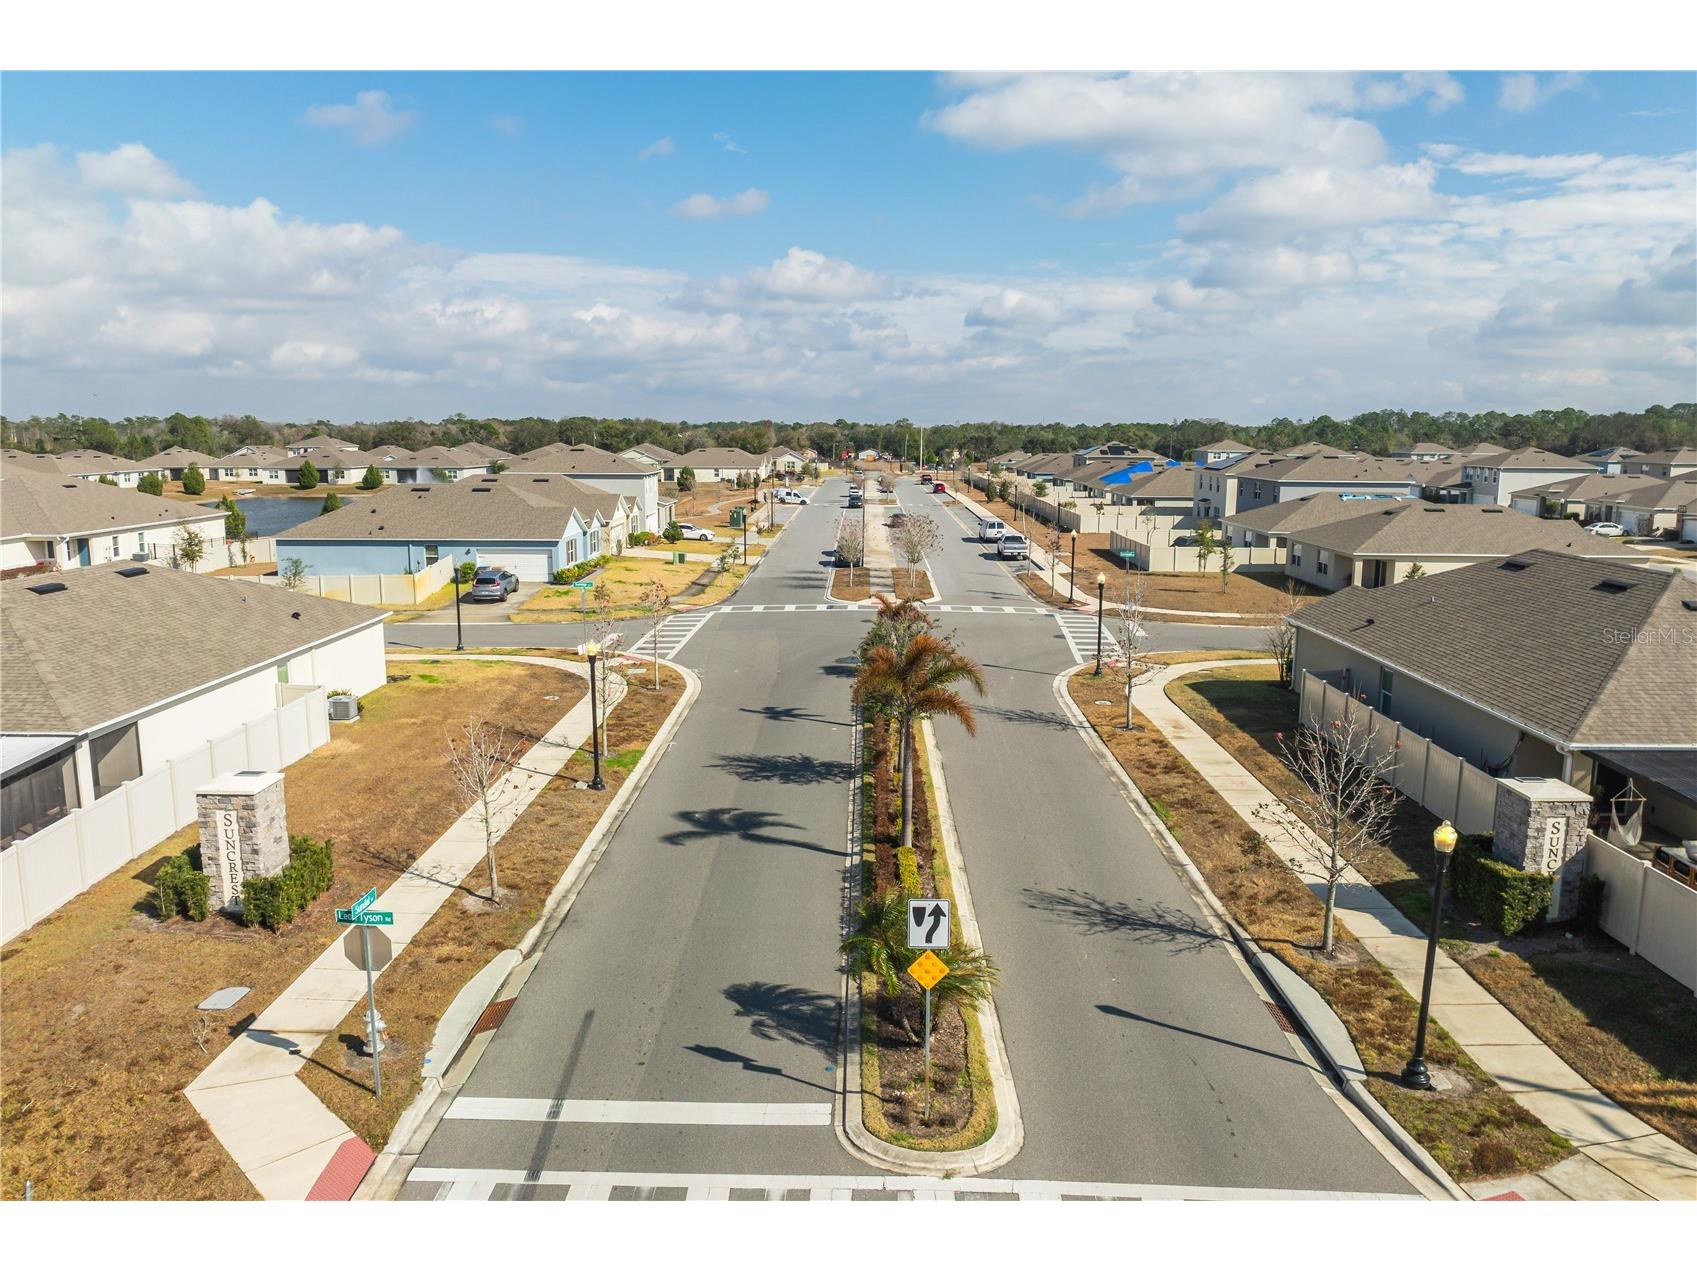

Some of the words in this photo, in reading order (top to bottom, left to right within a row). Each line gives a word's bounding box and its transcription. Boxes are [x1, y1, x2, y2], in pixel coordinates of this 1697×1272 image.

[223, 813, 240, 906] SUNCREST
[338, 911, 357, 921] Leo
[360, 913, 383, 924] Tyson
